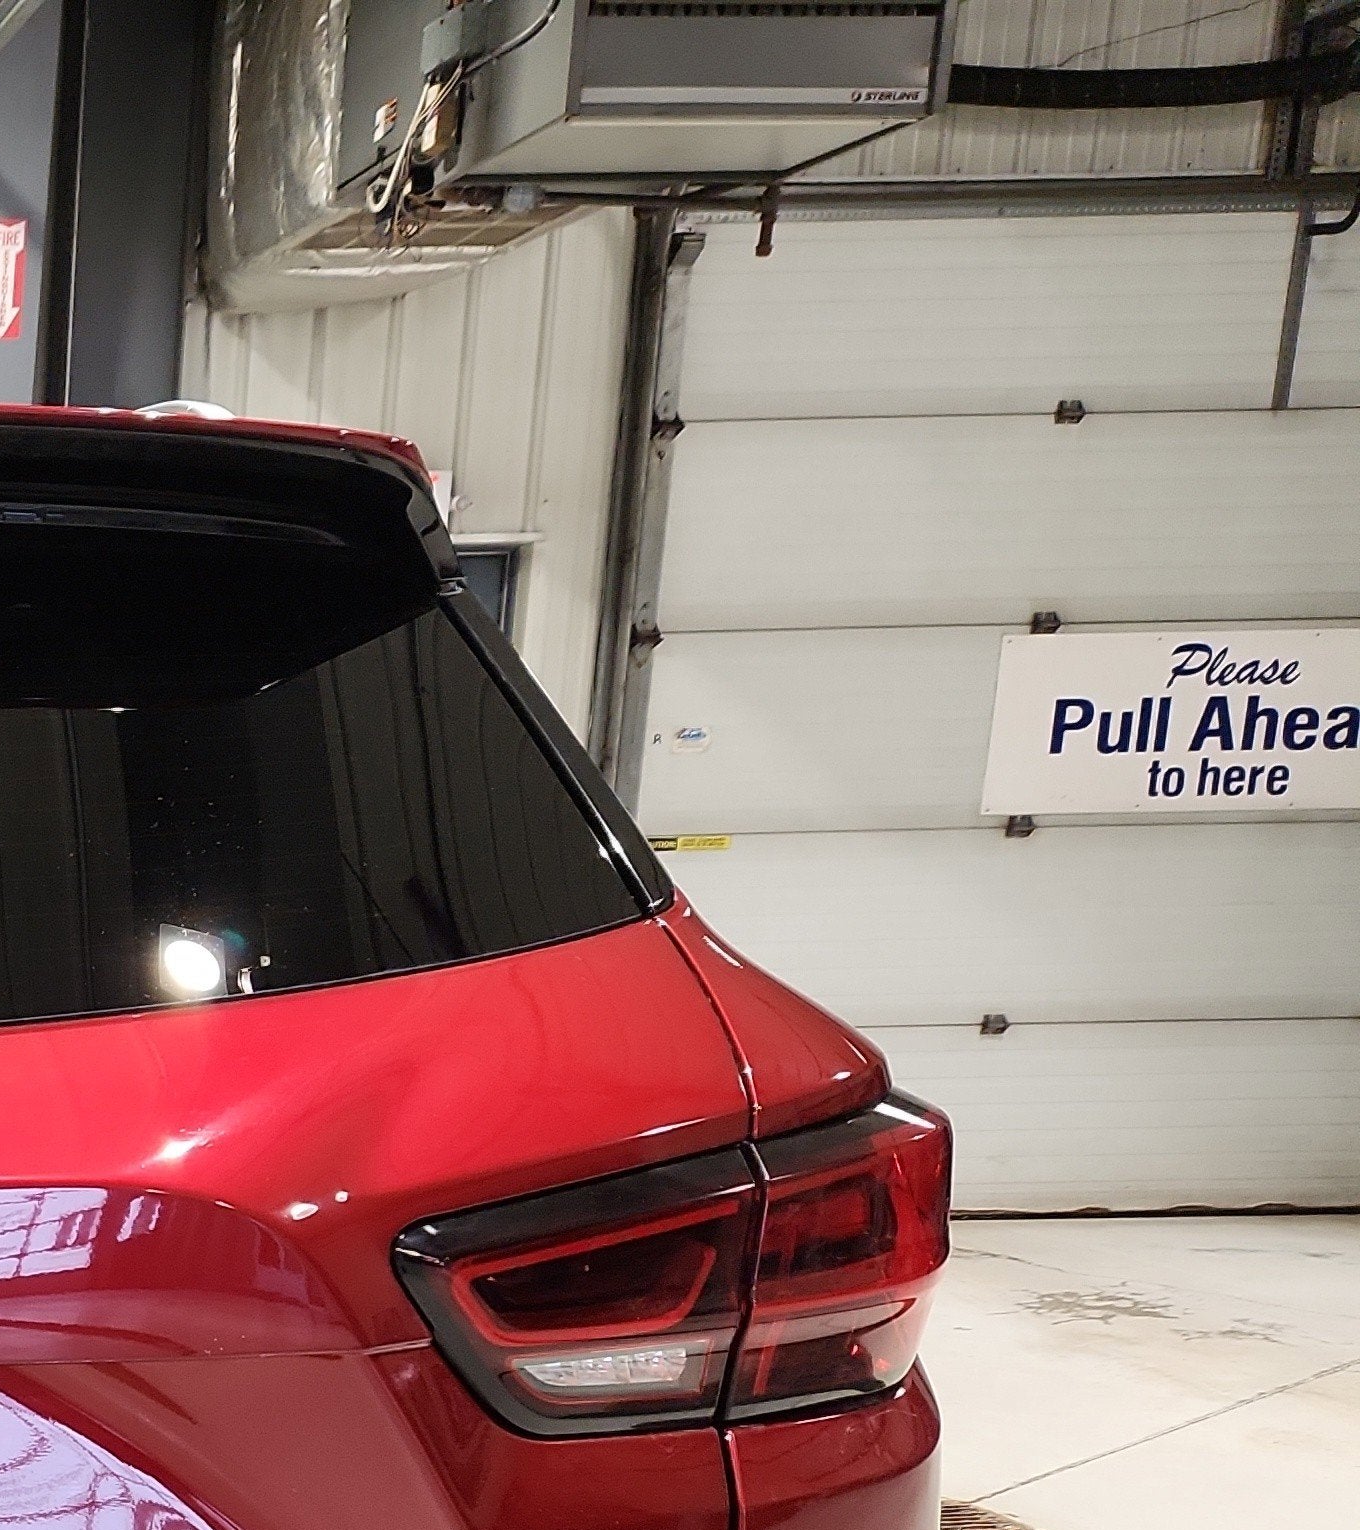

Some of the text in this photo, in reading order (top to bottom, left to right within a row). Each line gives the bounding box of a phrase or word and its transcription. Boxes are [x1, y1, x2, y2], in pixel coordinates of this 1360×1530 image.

[864, 90, 921, 101] STERLING
[1166, 642, 1301, 689] Please
[1049, 696, 1173, 755] Pull
[1147, 757, 1291, 798] to here
